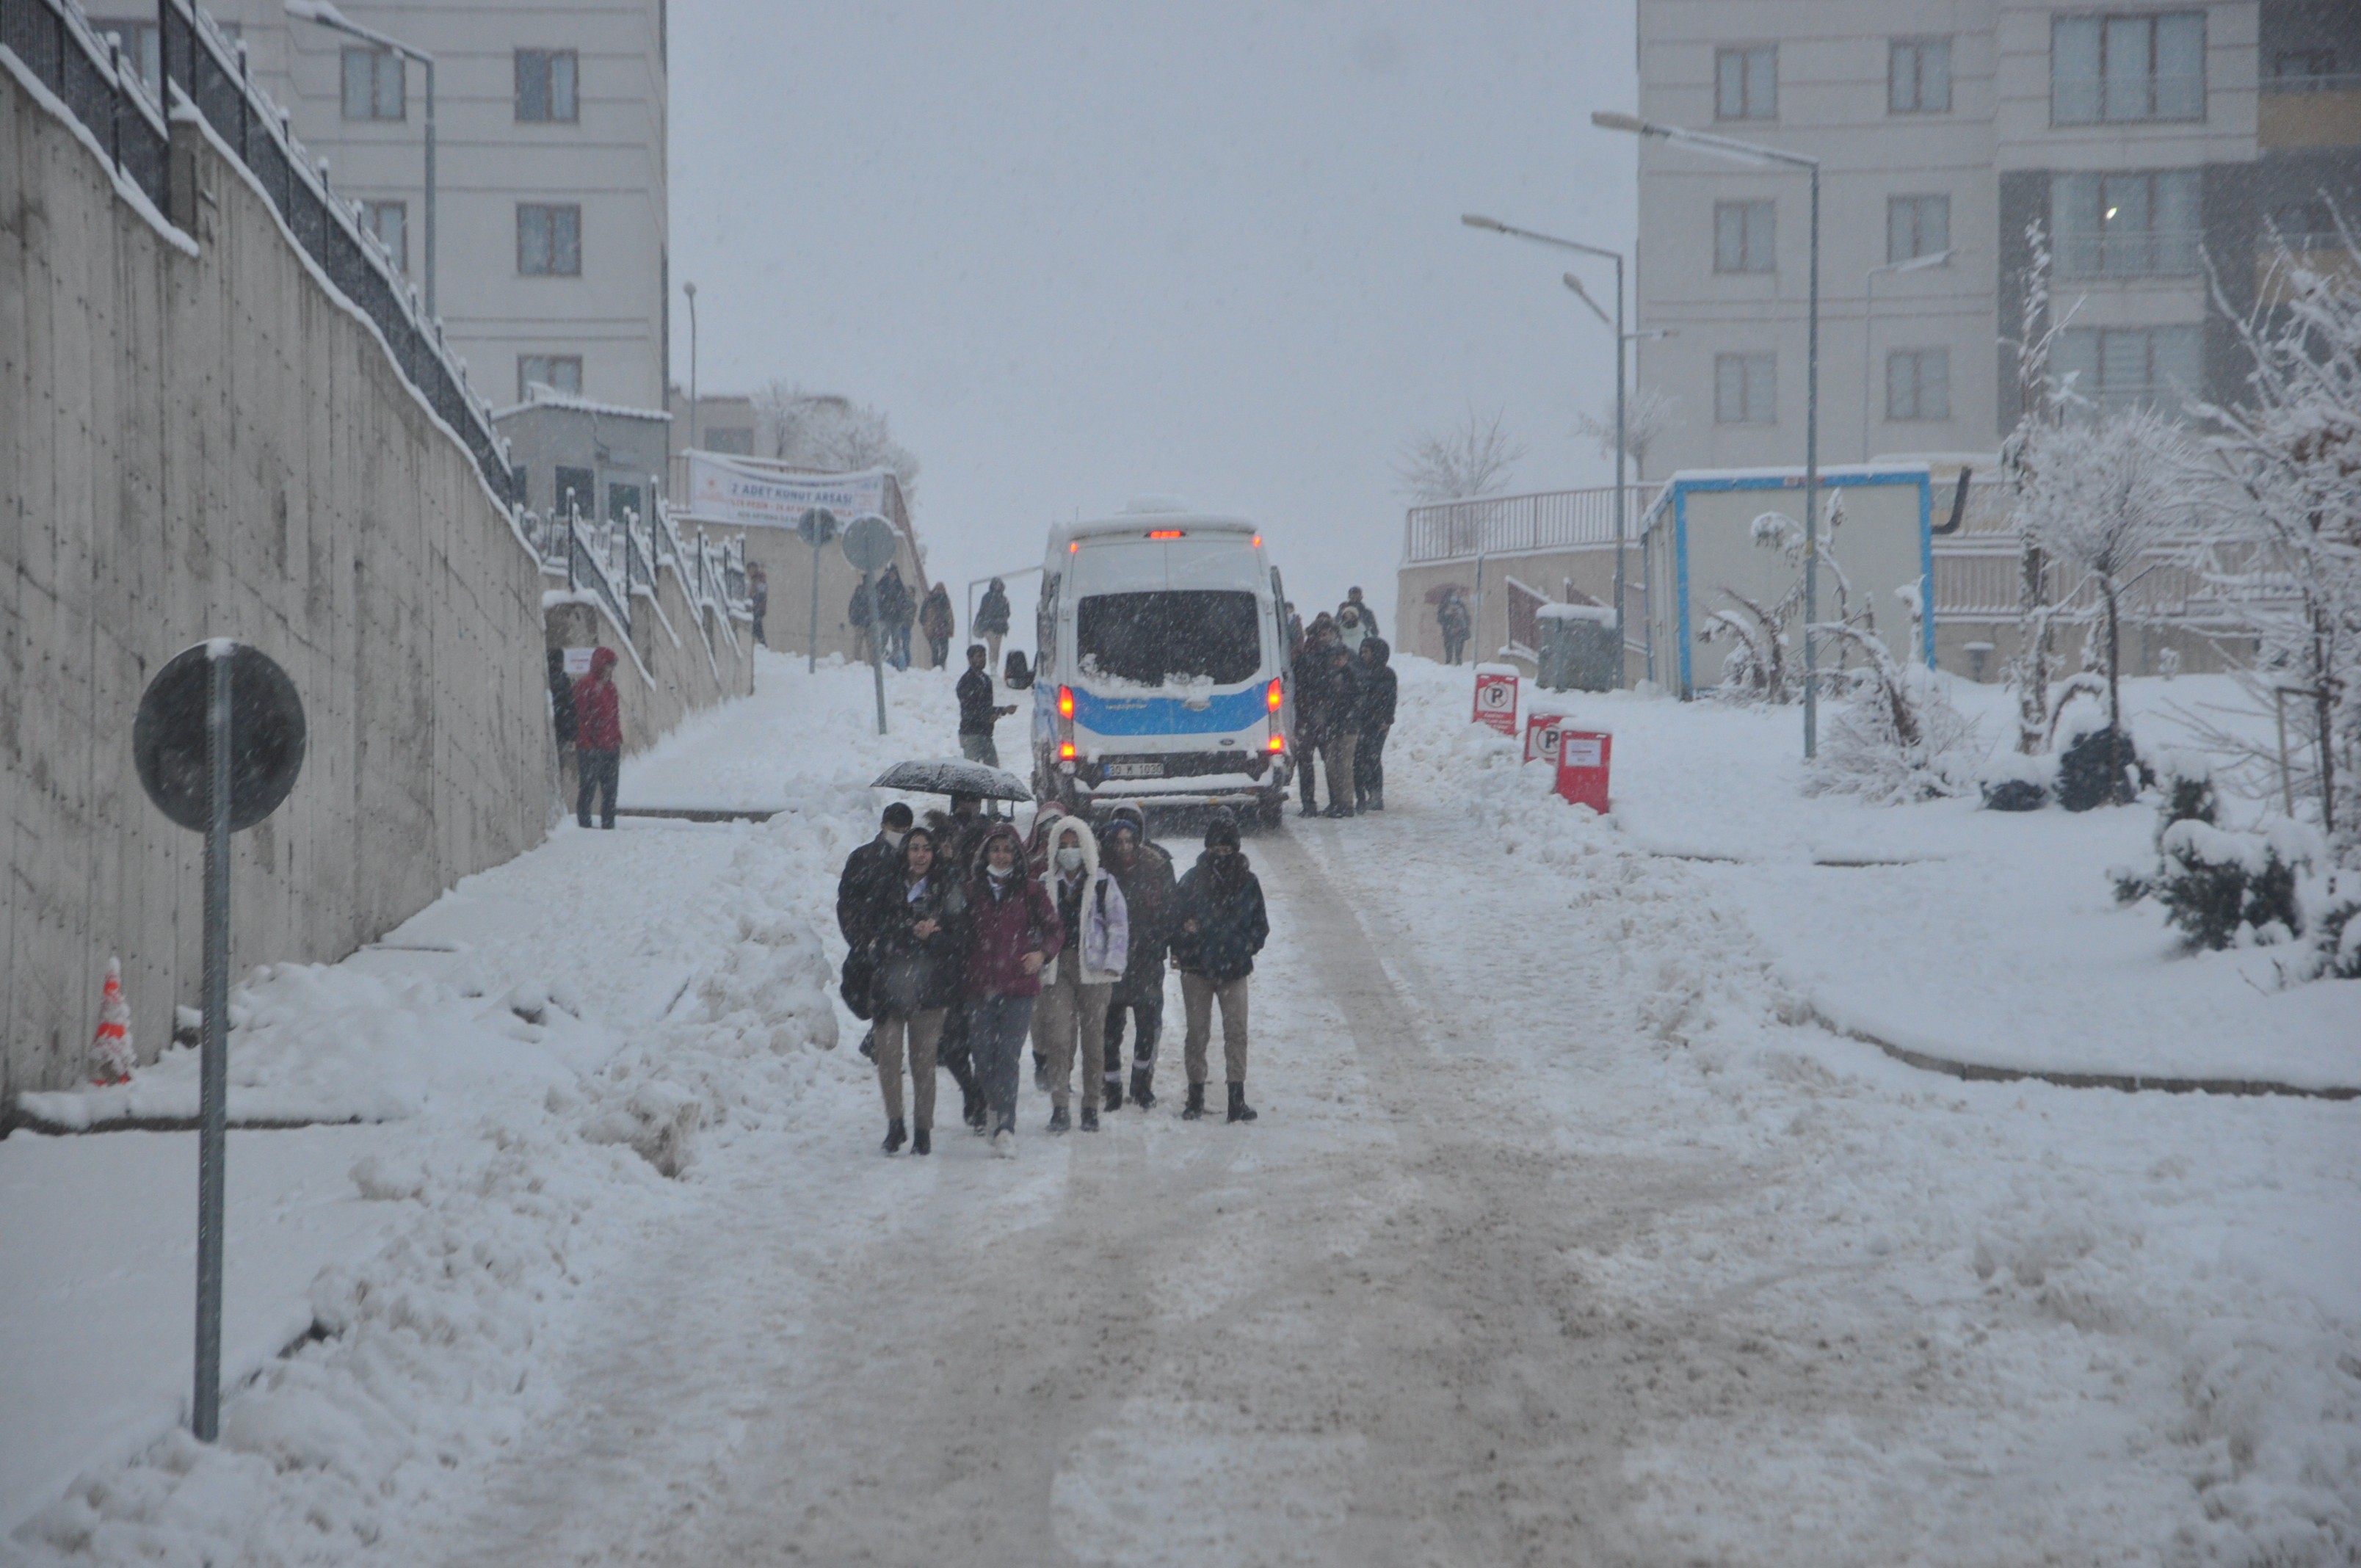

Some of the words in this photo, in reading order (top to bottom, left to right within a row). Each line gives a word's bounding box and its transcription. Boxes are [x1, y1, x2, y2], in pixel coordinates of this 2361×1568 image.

[742, 484, 772, 498] ADET
[775, 487, 811, 501] KONUT
[814, 490, 853, 505] ARSASI
